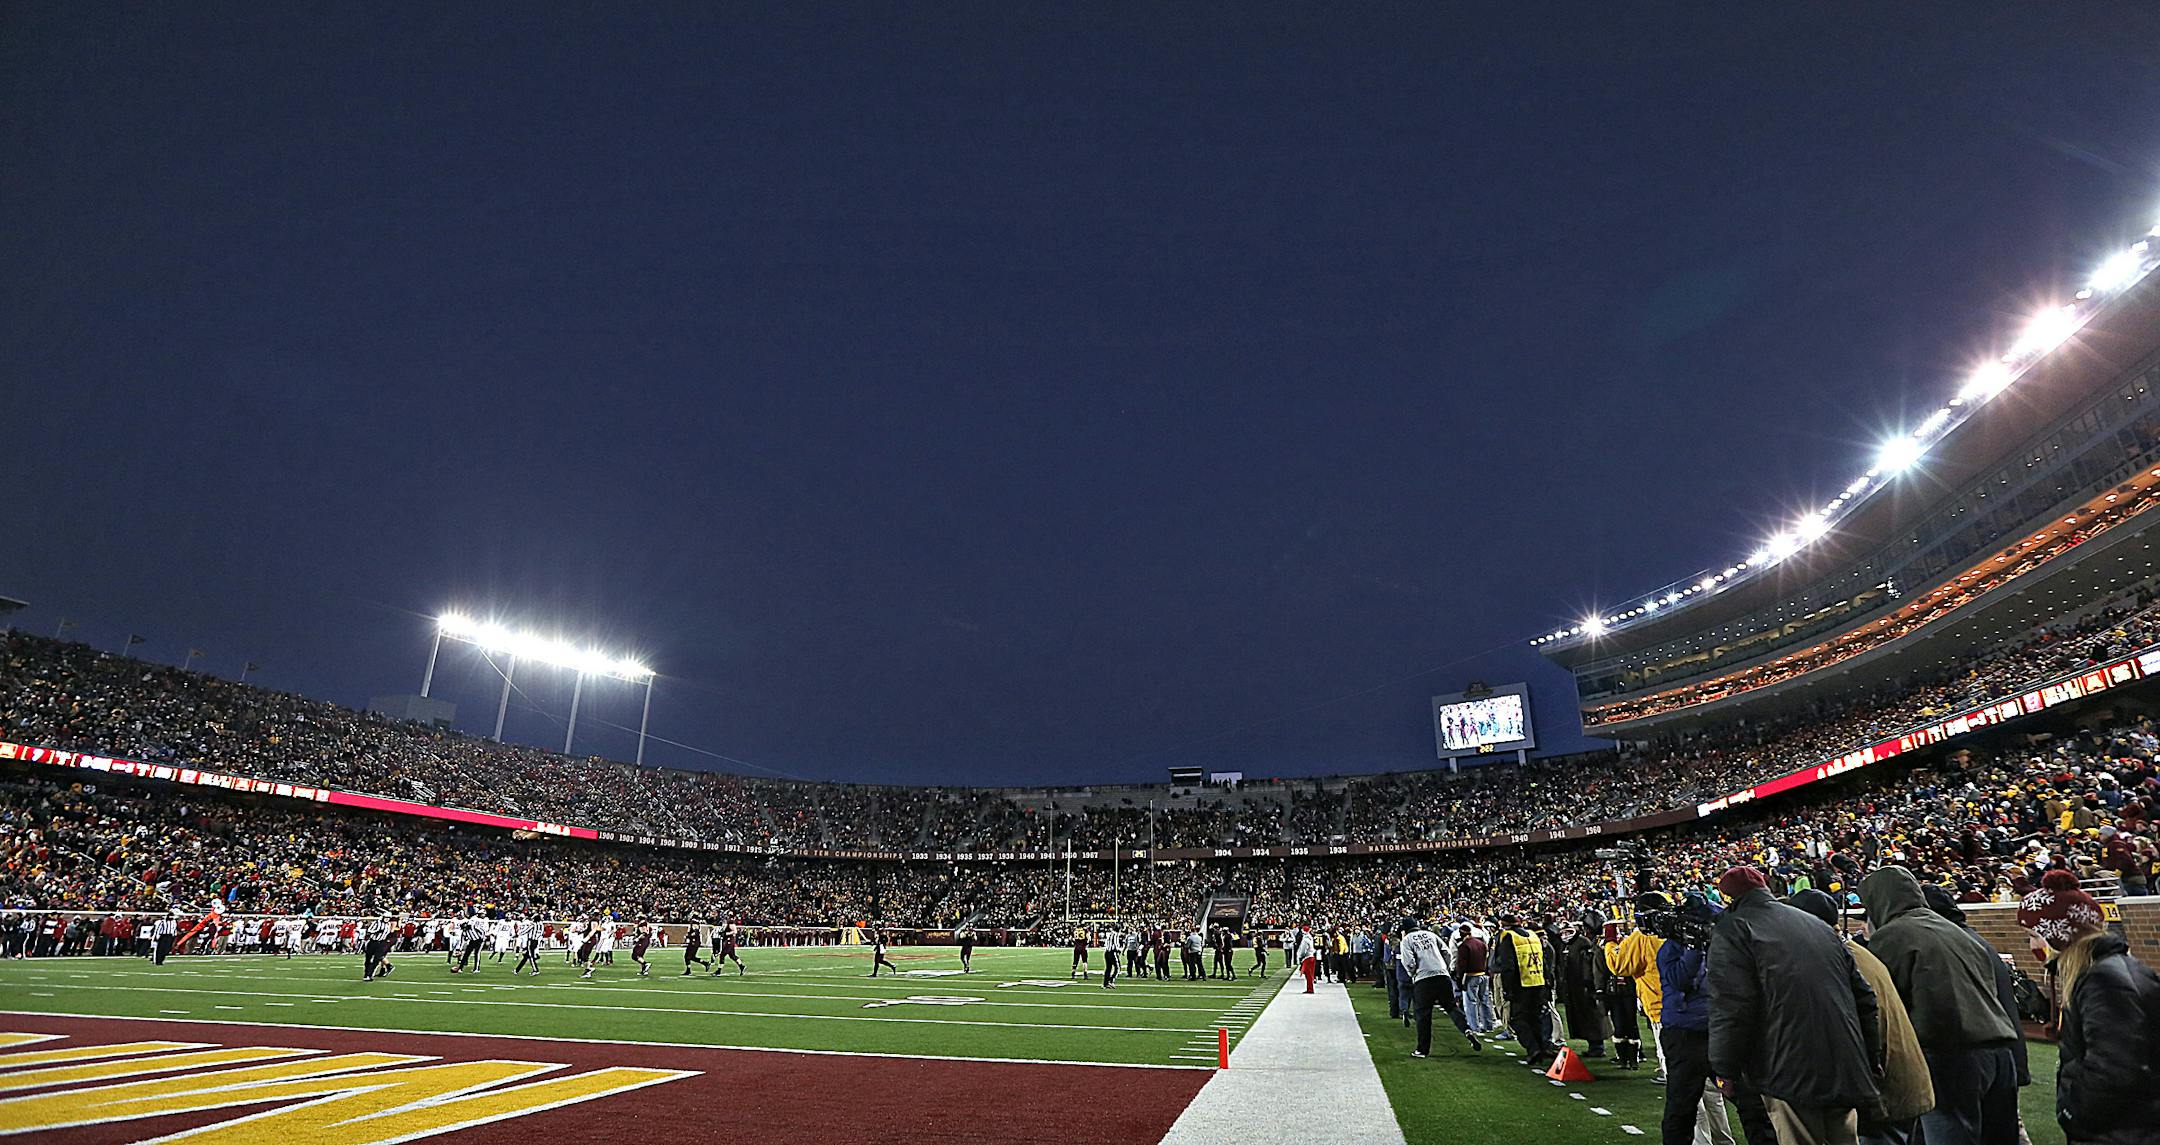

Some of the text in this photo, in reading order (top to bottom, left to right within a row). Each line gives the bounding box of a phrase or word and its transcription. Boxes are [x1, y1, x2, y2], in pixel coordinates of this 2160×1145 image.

[1511, 825, 1602, 843] 1940 1941 1960
[599, 831, 614, 840] 1900
[619, 834, 635, 842] 1903
[639, 836, 655, 845] 1904
[681, 840, 698, 848] 1909
[703, 842, 719, 850] 1910
[724, 844, 740, 852] 1911
[746, 846, 762, 854] 1915
[1368, 838, 1490, 852] NATIONAL CHAMPIONSHIPS
[835, 851, 903, 859] CHAMPIONSHIPS
[912, 852, 928, 860] 1933
[936, 852, 952, 860] 1934
[1019, 852, 1035, 860] 1940
[1040, 852, 1056, 860] 1941
[1214, 846, 1348, 857] 1904 1934 1935 1936
[2105, 907, 2118, 918] 14
[1074, 929, 1086, 940] 83
[1313, 936, 1323, 946] 31
